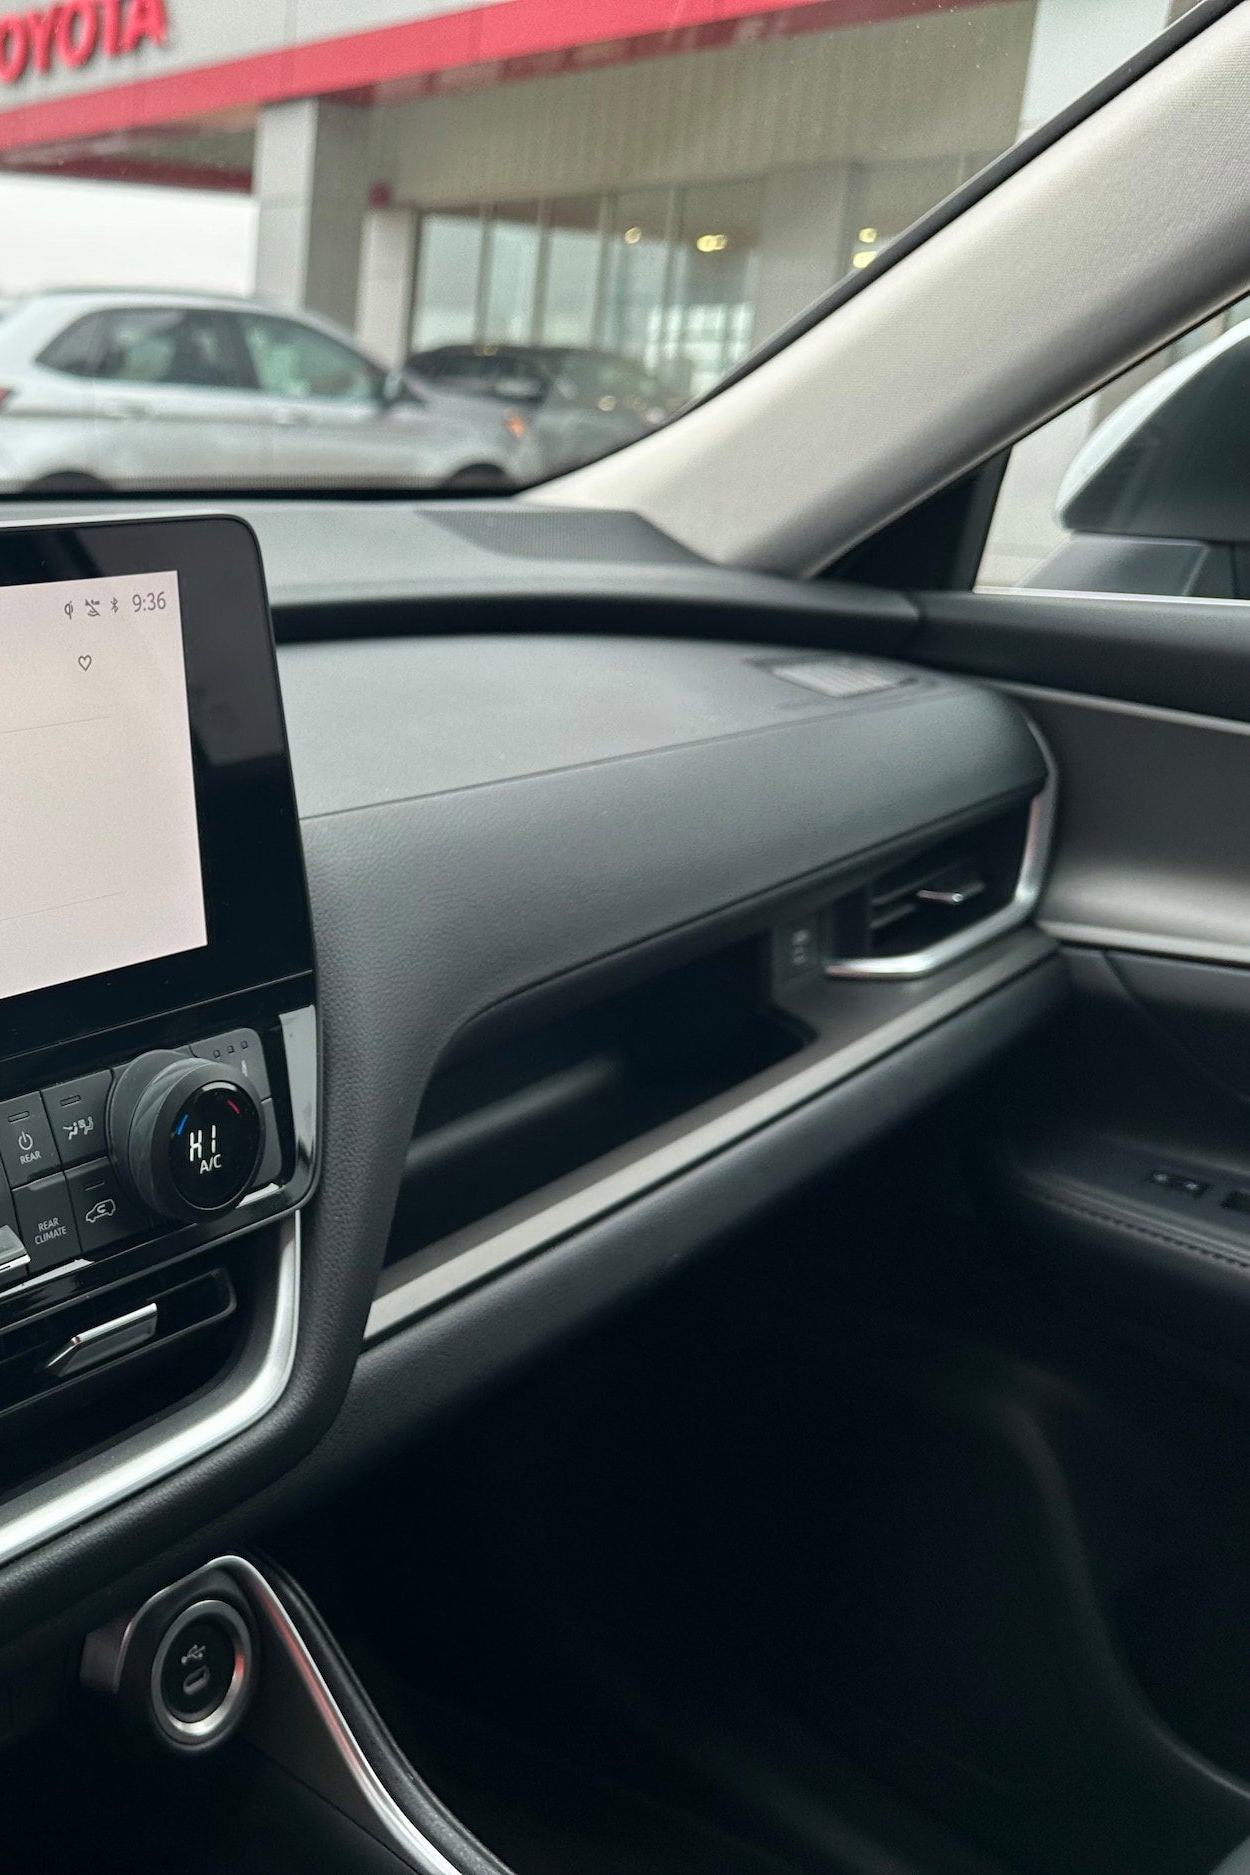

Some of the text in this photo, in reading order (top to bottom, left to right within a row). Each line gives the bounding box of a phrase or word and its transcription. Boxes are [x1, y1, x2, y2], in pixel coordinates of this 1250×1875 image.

[132, 591, 166, 613] 9:36
[20, 1150, 42, 1164] REAR
[199, 1153, 222, 1174] A/C
[38, 1217, 60, 1232] REAR
[34, 1226, 67, 1245] CLIMATE
